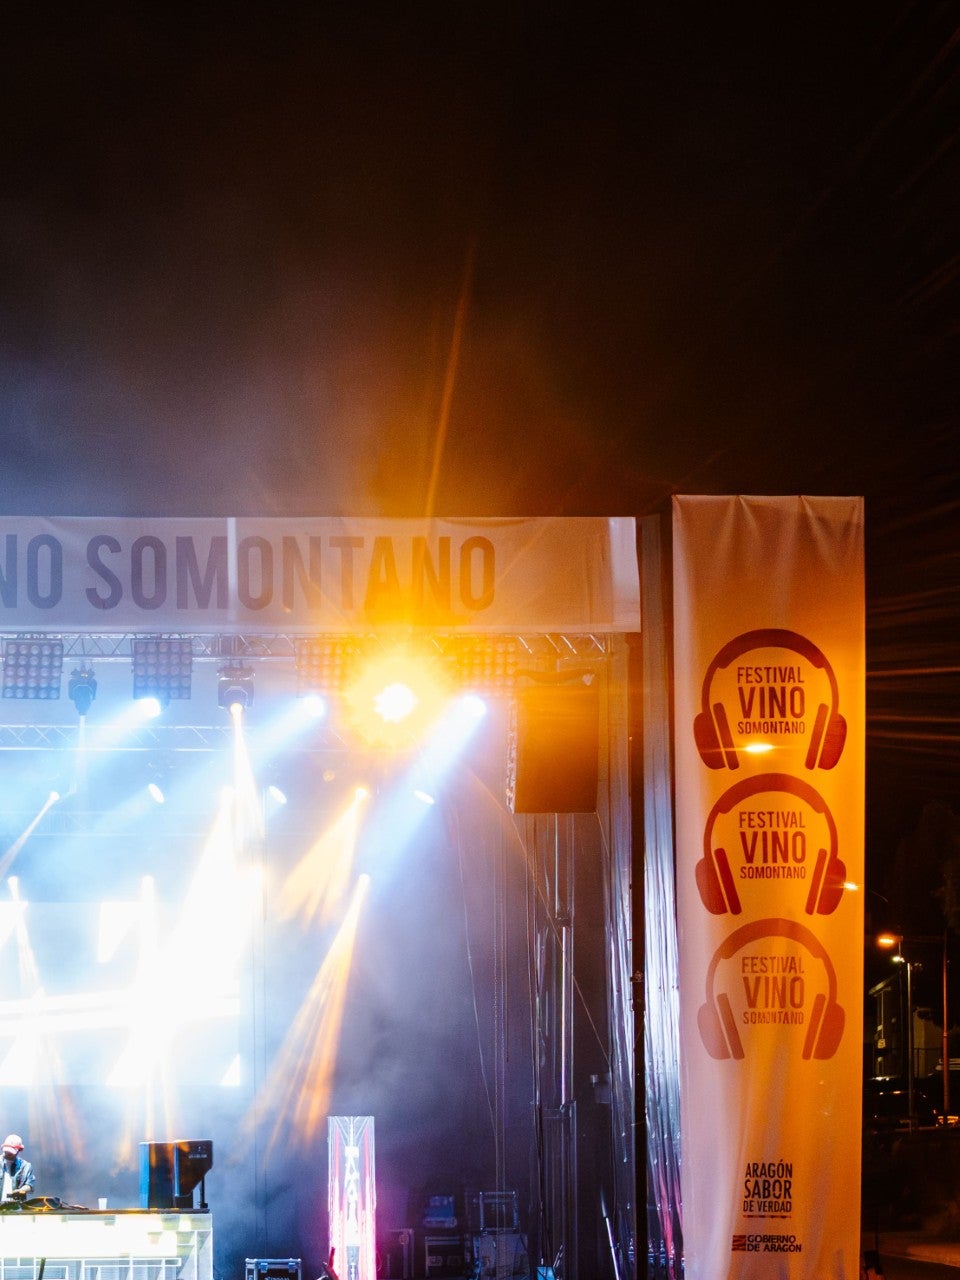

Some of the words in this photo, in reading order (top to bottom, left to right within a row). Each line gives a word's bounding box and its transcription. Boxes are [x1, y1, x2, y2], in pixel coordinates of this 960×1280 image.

[85, 534, 497, 613] SOMONTANO
[737, 666, 805, 684] FESTIVAL
[738, 685, 806, 719] VINO
[737, 720, 806, 735] SOMONTANO
[739, 811, 806, 829] FESTIVAL
[740, 830, 807, 864] VINO
[740, 865, 807, 880] SOMONTANO
[742, 956, 805, 974] FESTIVAL
[742, 975, 805, 1010] VINO
[742, 1011, 805, 1025] SOMONTANO
[745, 1158, 793, 1179] ARAGÓN
[744, 1179, 792, 1200] SABOR
[742, 1200, 754, 1213] DE
[757, 1200, 792, 1213] VERDAD
[747, 1234, 797, 1244] GOBIERNO
[747, 1243, 761, 1252] DE
